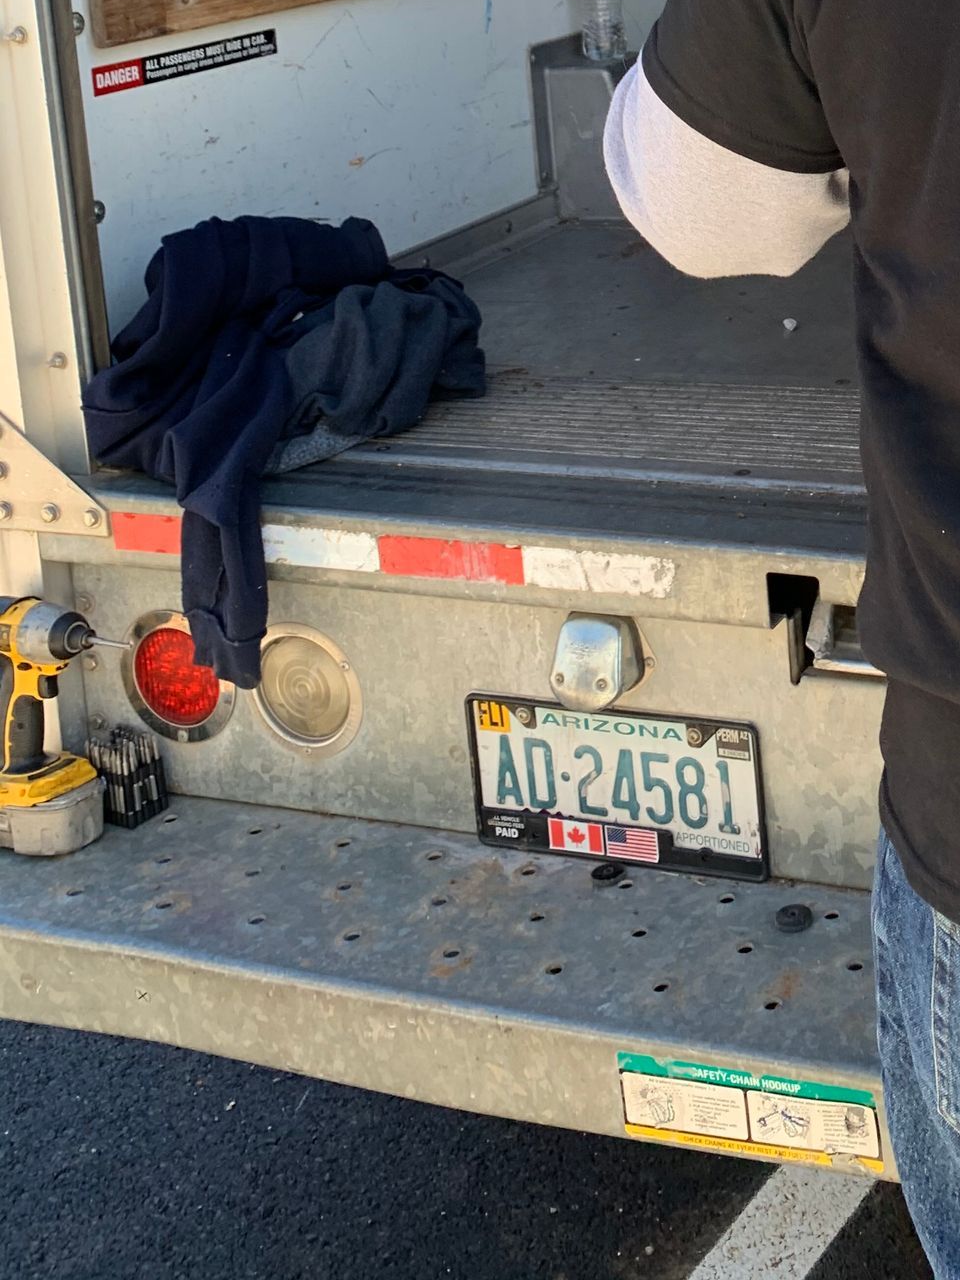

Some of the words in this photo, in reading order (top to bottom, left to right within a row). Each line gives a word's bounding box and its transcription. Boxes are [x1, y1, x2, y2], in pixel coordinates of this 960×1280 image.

[146, 59, 159, 71] ALL
[160, 48, 204, 68] PASSENGERS
[206, 42, 225, 57] MUST
[226, 40, 242, 53] RIDE
[243, 37, 250, 49] IN
[96, 65, 140, 89] DANGER
[541, 712, 684, 743] ARIZONA
[716, 728, 739, 743] PERM
[740, 730, 749, 740] AZ
[495, 826, 519, 838] PAID
[675, 831, 751, 854] APPORTIONED
[761, 1077, 802, 1094] HOOKUP
